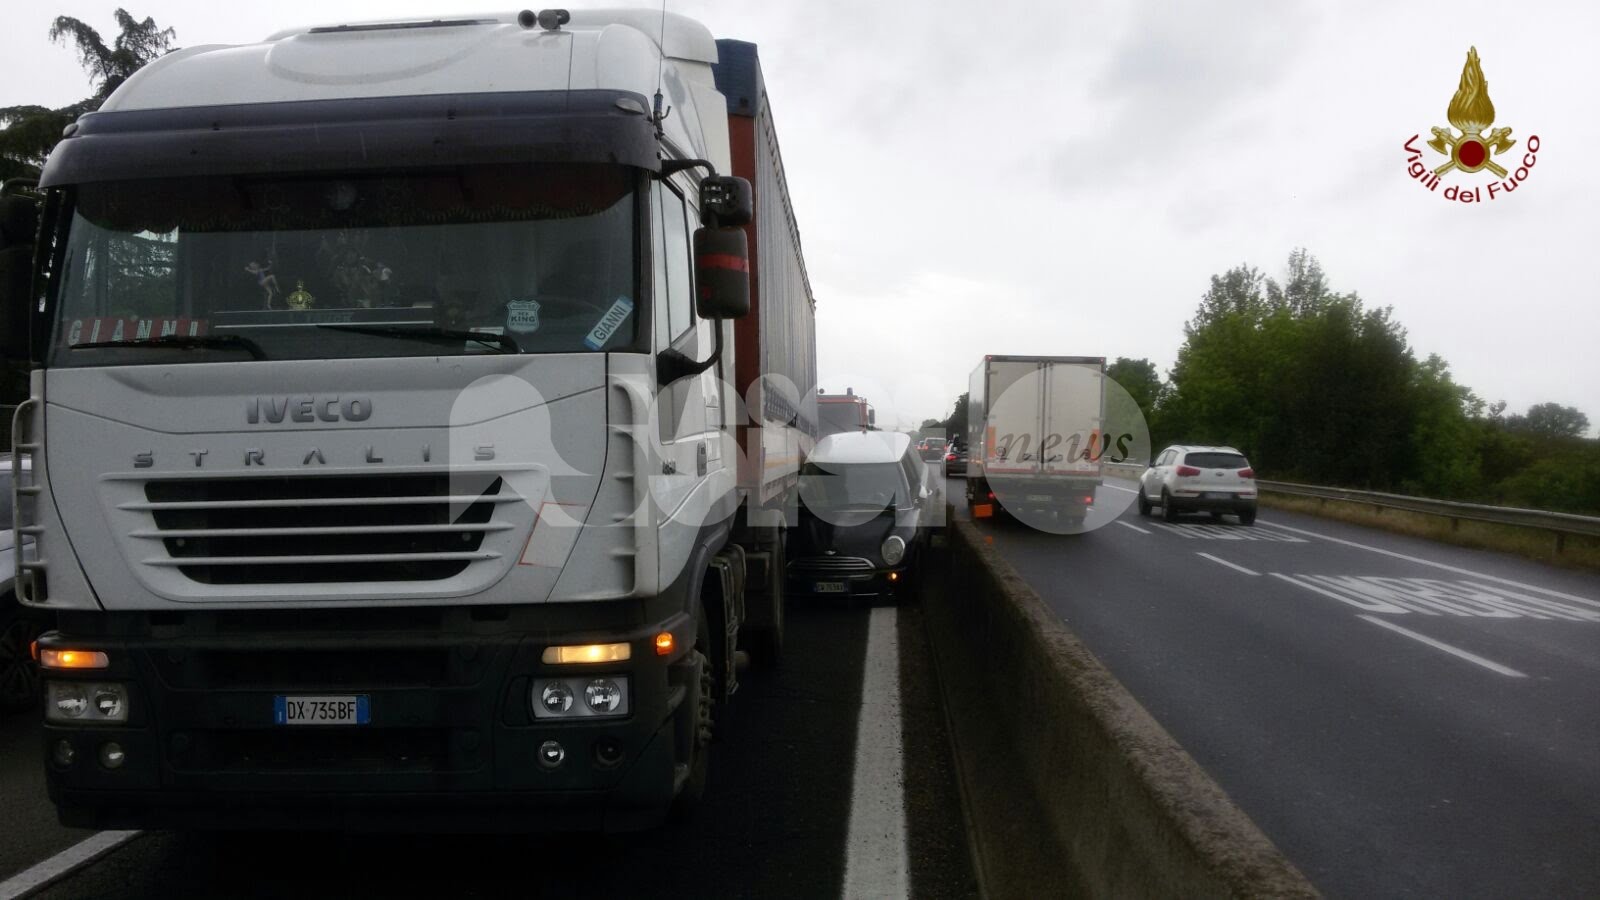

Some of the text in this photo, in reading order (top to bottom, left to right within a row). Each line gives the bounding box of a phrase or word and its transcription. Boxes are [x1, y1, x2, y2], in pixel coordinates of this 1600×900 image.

[68, 318, 199, 346] GIANNI
[593, 304, 628, 341] GIANNI
[246, 397, 372, 424] IVECO
[134, 443, 495, 468] STRALIS
[287, 701, 356, 720] DX 735BF
